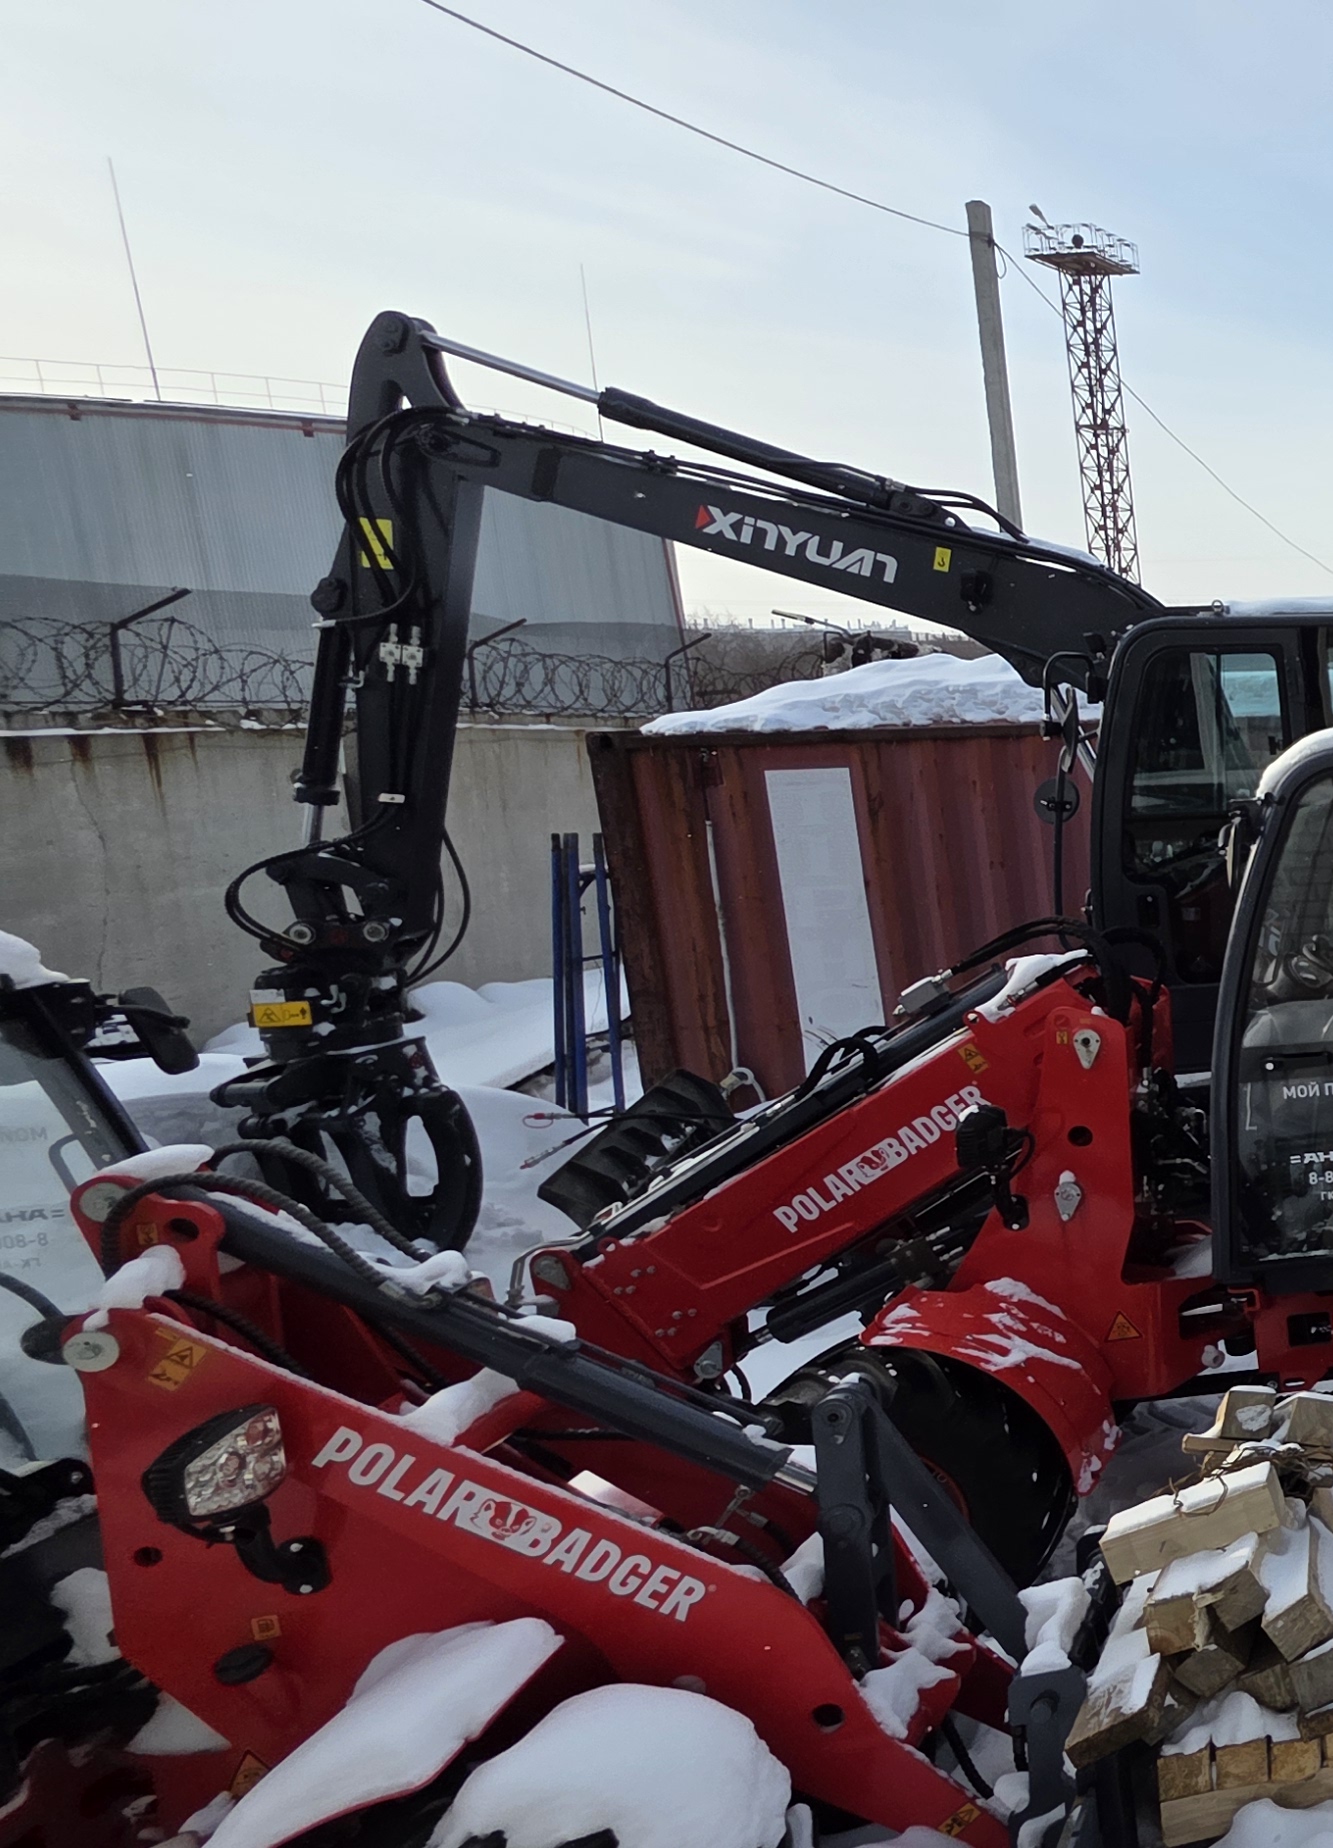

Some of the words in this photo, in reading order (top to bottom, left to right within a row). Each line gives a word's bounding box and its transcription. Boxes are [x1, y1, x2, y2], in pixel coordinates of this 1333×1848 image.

[1283, 1082, 1320, 1099] МОЙ
[773, 1162, 868, 1233] POLAR
[311, 1426, 480, 1528] POLAR
[525, 1510, 706, 1622] BADGER
